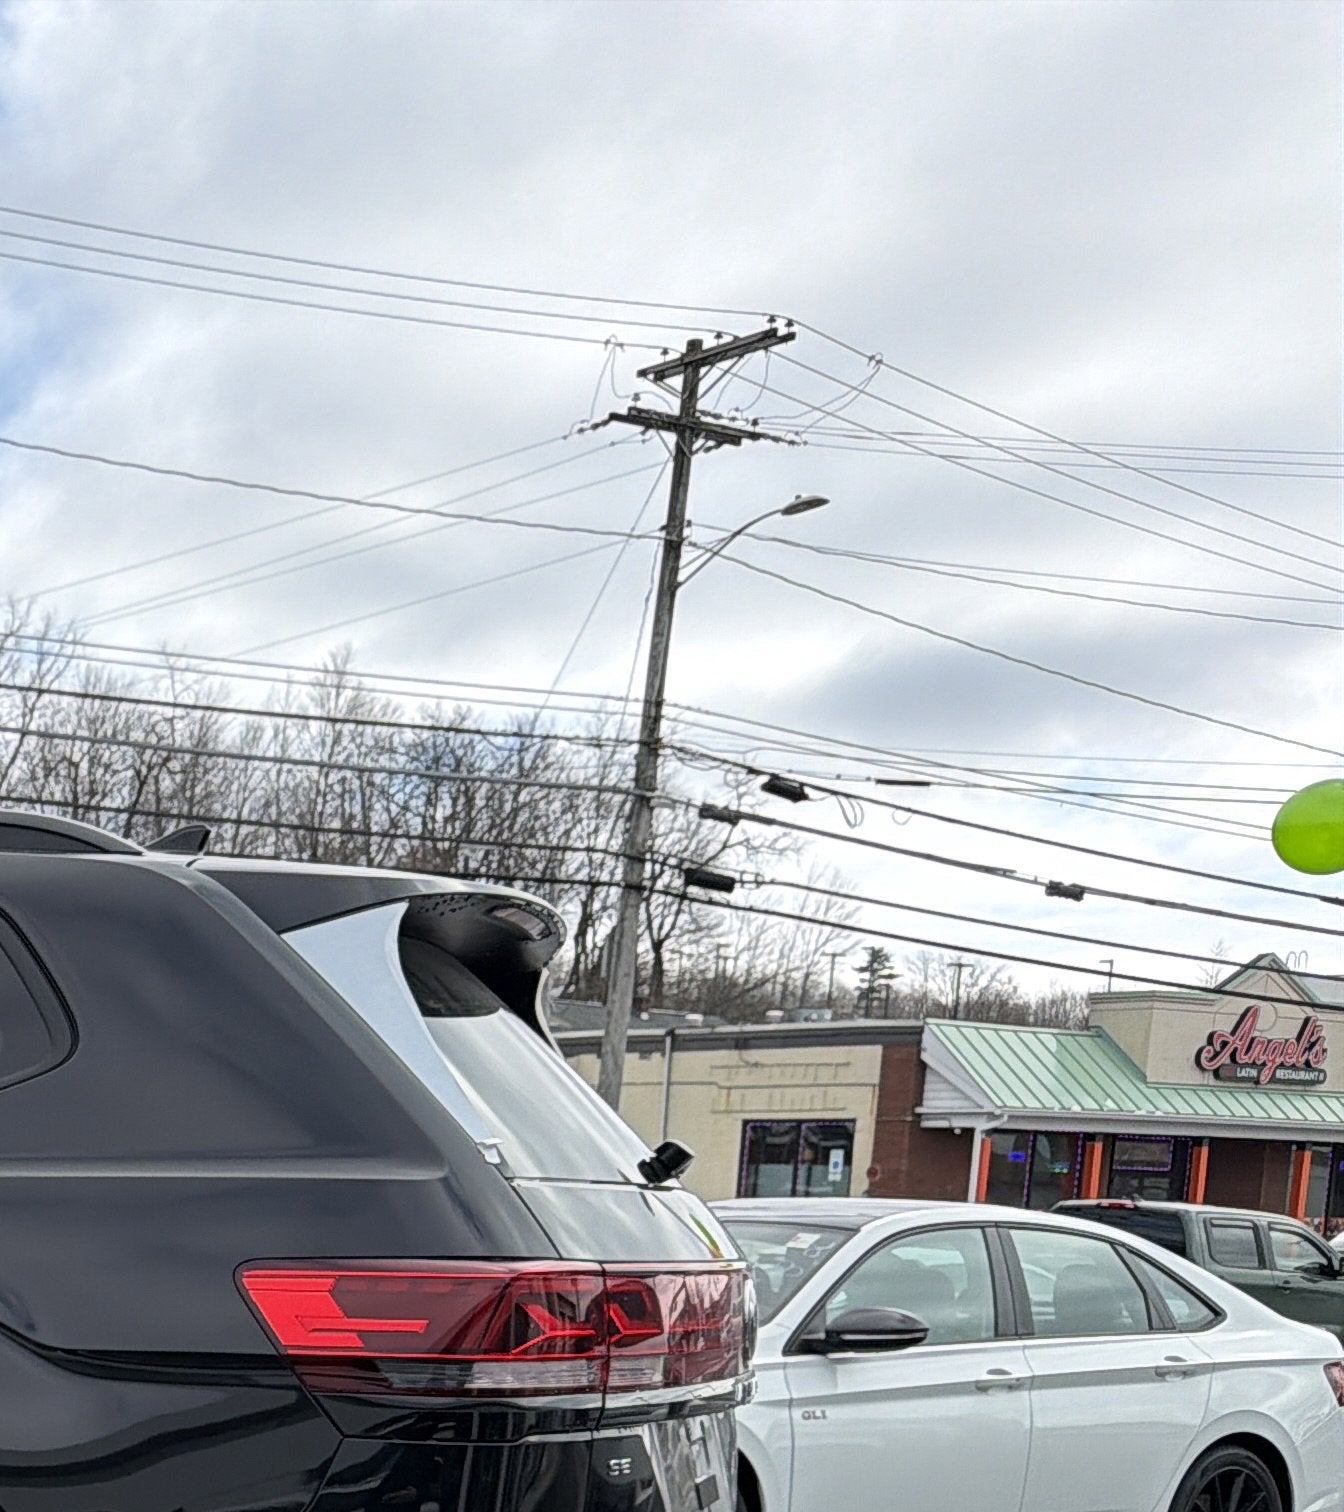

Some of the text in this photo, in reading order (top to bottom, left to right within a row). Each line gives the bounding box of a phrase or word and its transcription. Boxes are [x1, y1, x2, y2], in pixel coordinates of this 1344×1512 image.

[1196, 1004, 1327, 1085] Angel's
[1236, 1067, 1258, 1078] LATIN
[1275, 1068, 1318, 1080] RESTAURANT
[801, 1409, 827, 1420] GLI
[608, 1457, 632, 1476] SE
